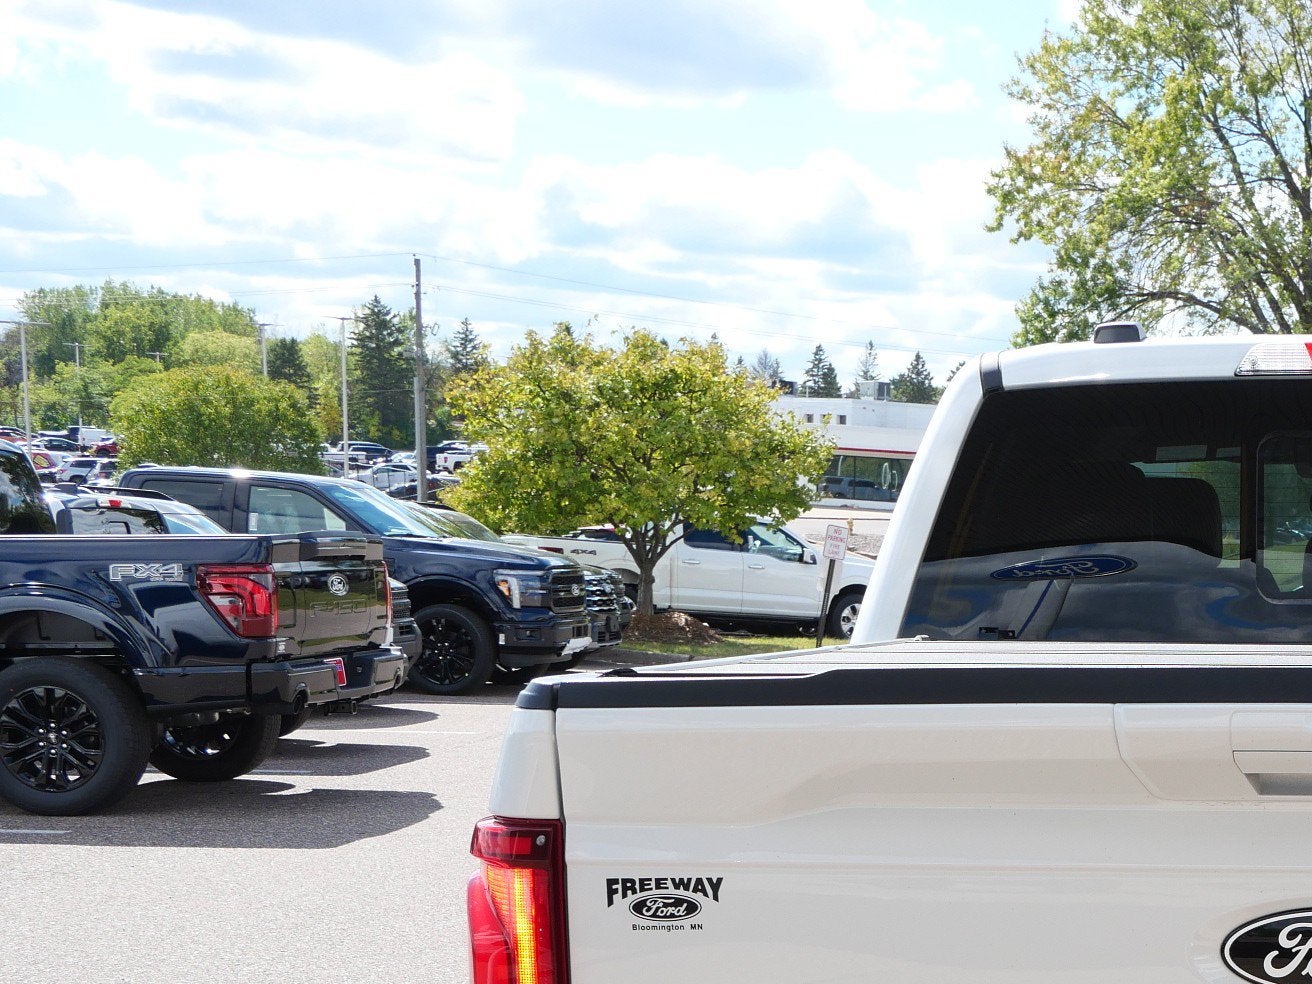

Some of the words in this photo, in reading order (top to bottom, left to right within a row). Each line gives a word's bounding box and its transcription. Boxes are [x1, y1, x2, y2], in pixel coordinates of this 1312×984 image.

[834, 528, 843, 536] NO
[109, 563, 184, 582] FX4
[605, 877, 724, 908] FREEWAY
[642, 898, 688, 917] Ford
[632, 923, 685, 932] Bloomington
[690, 923, 703, 931] MN
